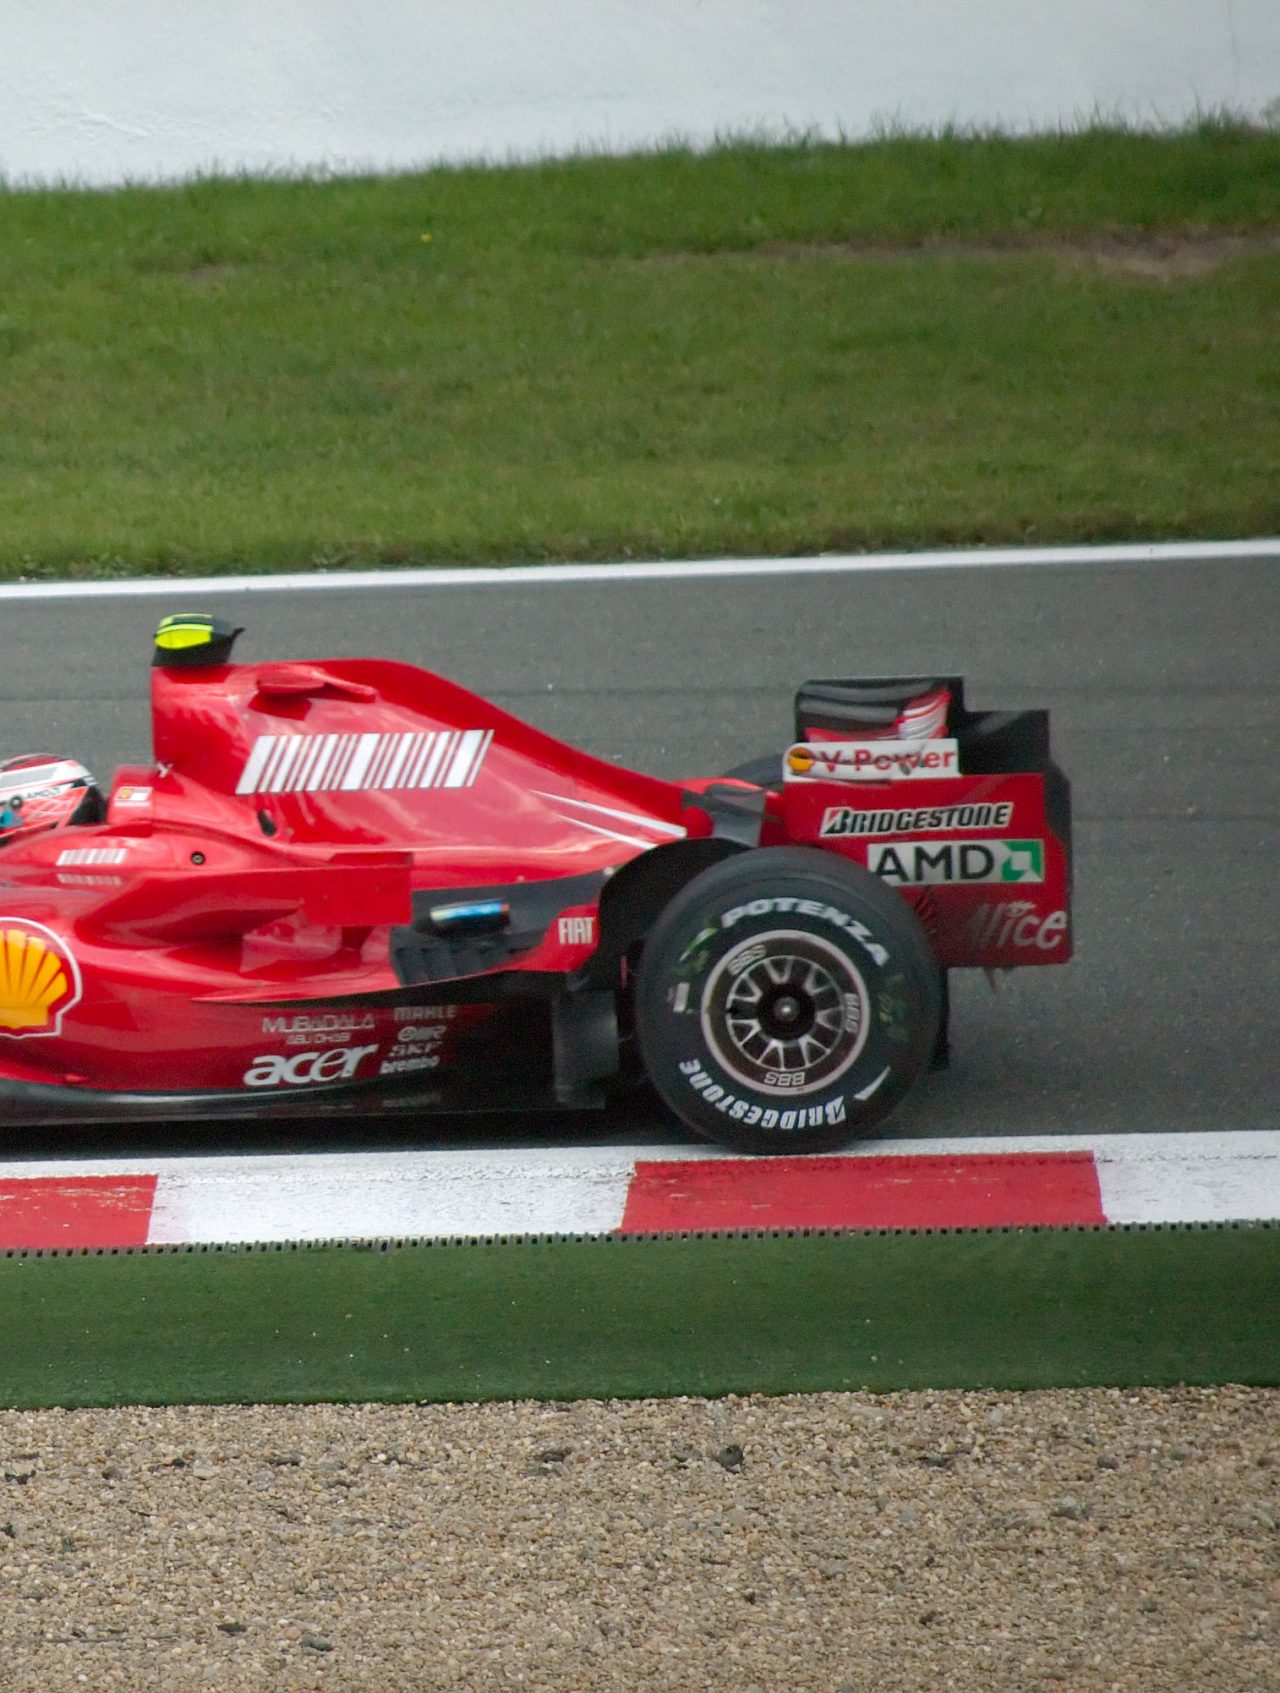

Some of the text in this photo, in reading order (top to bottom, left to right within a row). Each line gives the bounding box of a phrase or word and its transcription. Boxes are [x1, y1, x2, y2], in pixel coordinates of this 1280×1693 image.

[820, 748, 956, 773] V-Power
[822, 805, 1010, 835] BRIDGESTONE
[875, 844, 996, 883] AMD
[558, 916, 595, 945] FIAT
[721, 897, 890, 967] POTENZA
[243, 1043, 379, 1086] acer
[764, 1071, 806, 1086] BBS
[679, 1058, 847, 1130] BRIDGESTONE
